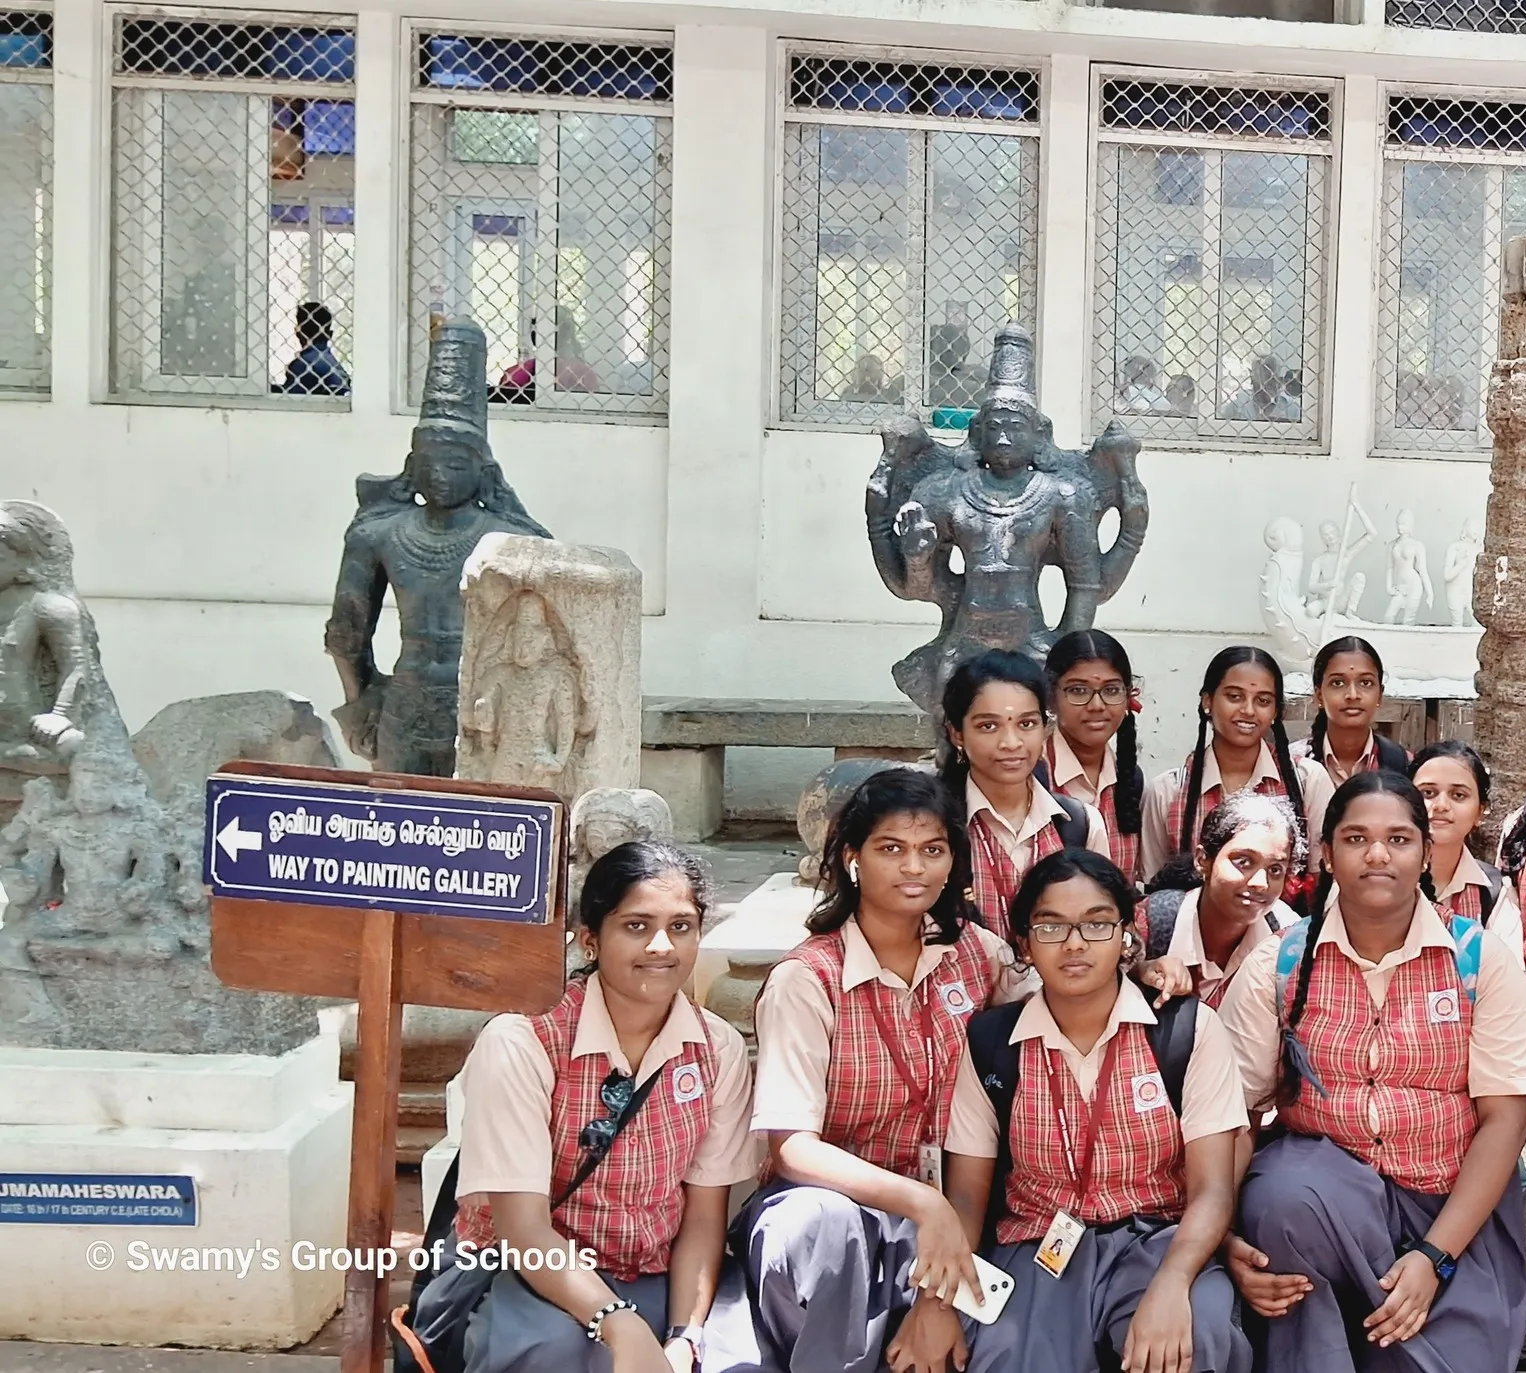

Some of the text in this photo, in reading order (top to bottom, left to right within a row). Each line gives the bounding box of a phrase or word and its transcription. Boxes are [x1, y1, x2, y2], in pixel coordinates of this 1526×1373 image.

[268, 806, 526, 861] ஓவிய அரங்கு செல்லும் வழி
[268, 853, 521, 899] WAY TO PAINTING GALLERY
[51, 1204, 60, 1215] 17
[70, 1205, 110, 1216] CENTURY
